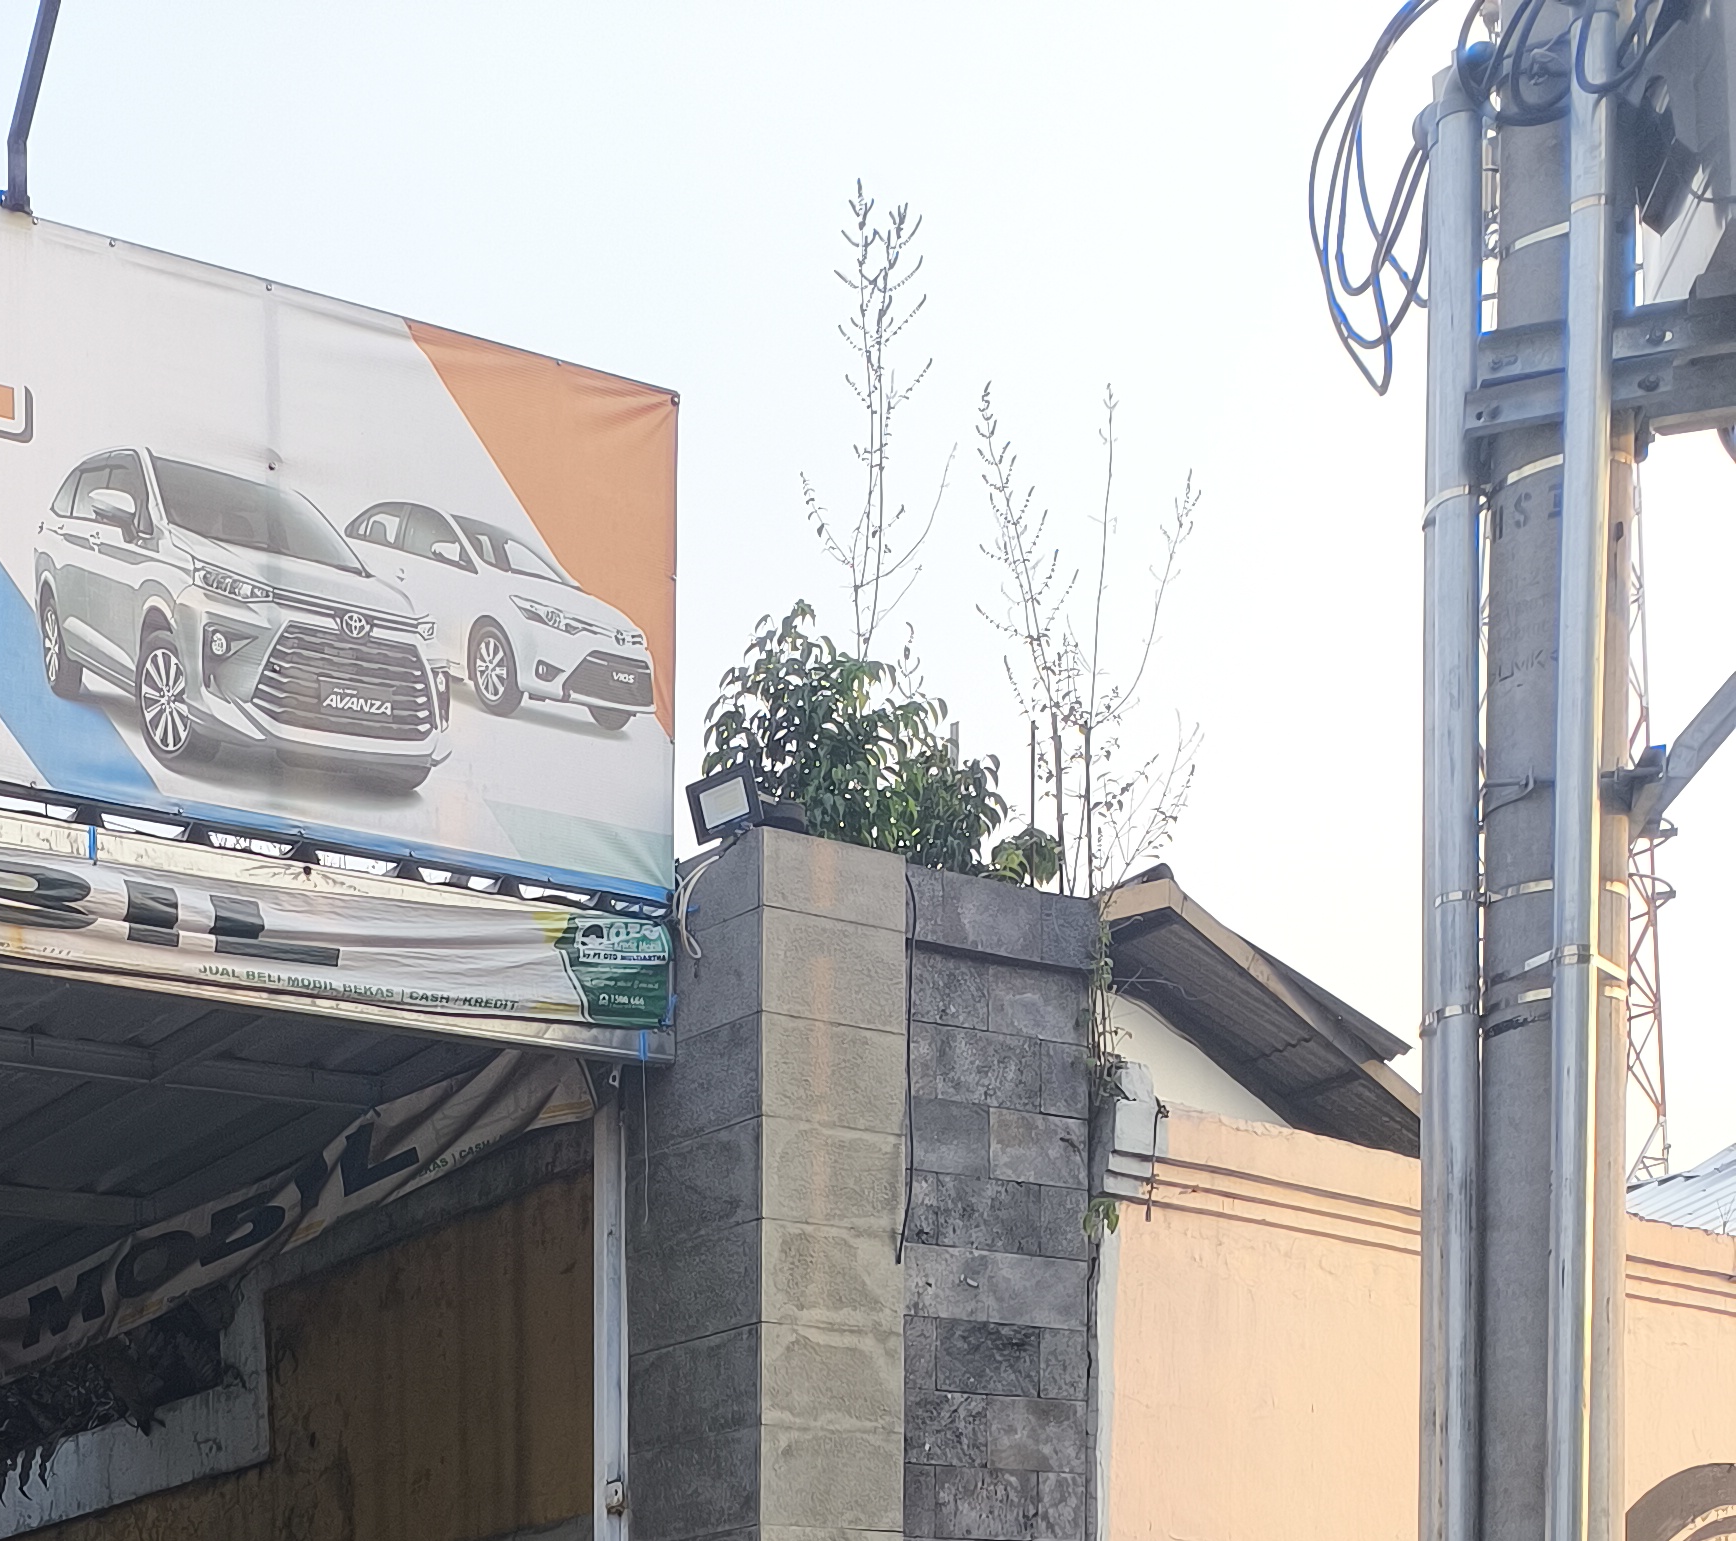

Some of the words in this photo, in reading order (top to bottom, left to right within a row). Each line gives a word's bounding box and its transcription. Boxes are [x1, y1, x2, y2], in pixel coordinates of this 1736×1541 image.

[322, 694, 392, 716] AVANZA
[198, 964, 241, 981] JUAL
[245, 971, 285, 986] BELI
[286, 975, 338, 993] MOBIL
[343, 983, 395, 999] BEKAS
[409, 990, 451, 1007] CASH
[461, 995, 520, 1012] KREDIT
